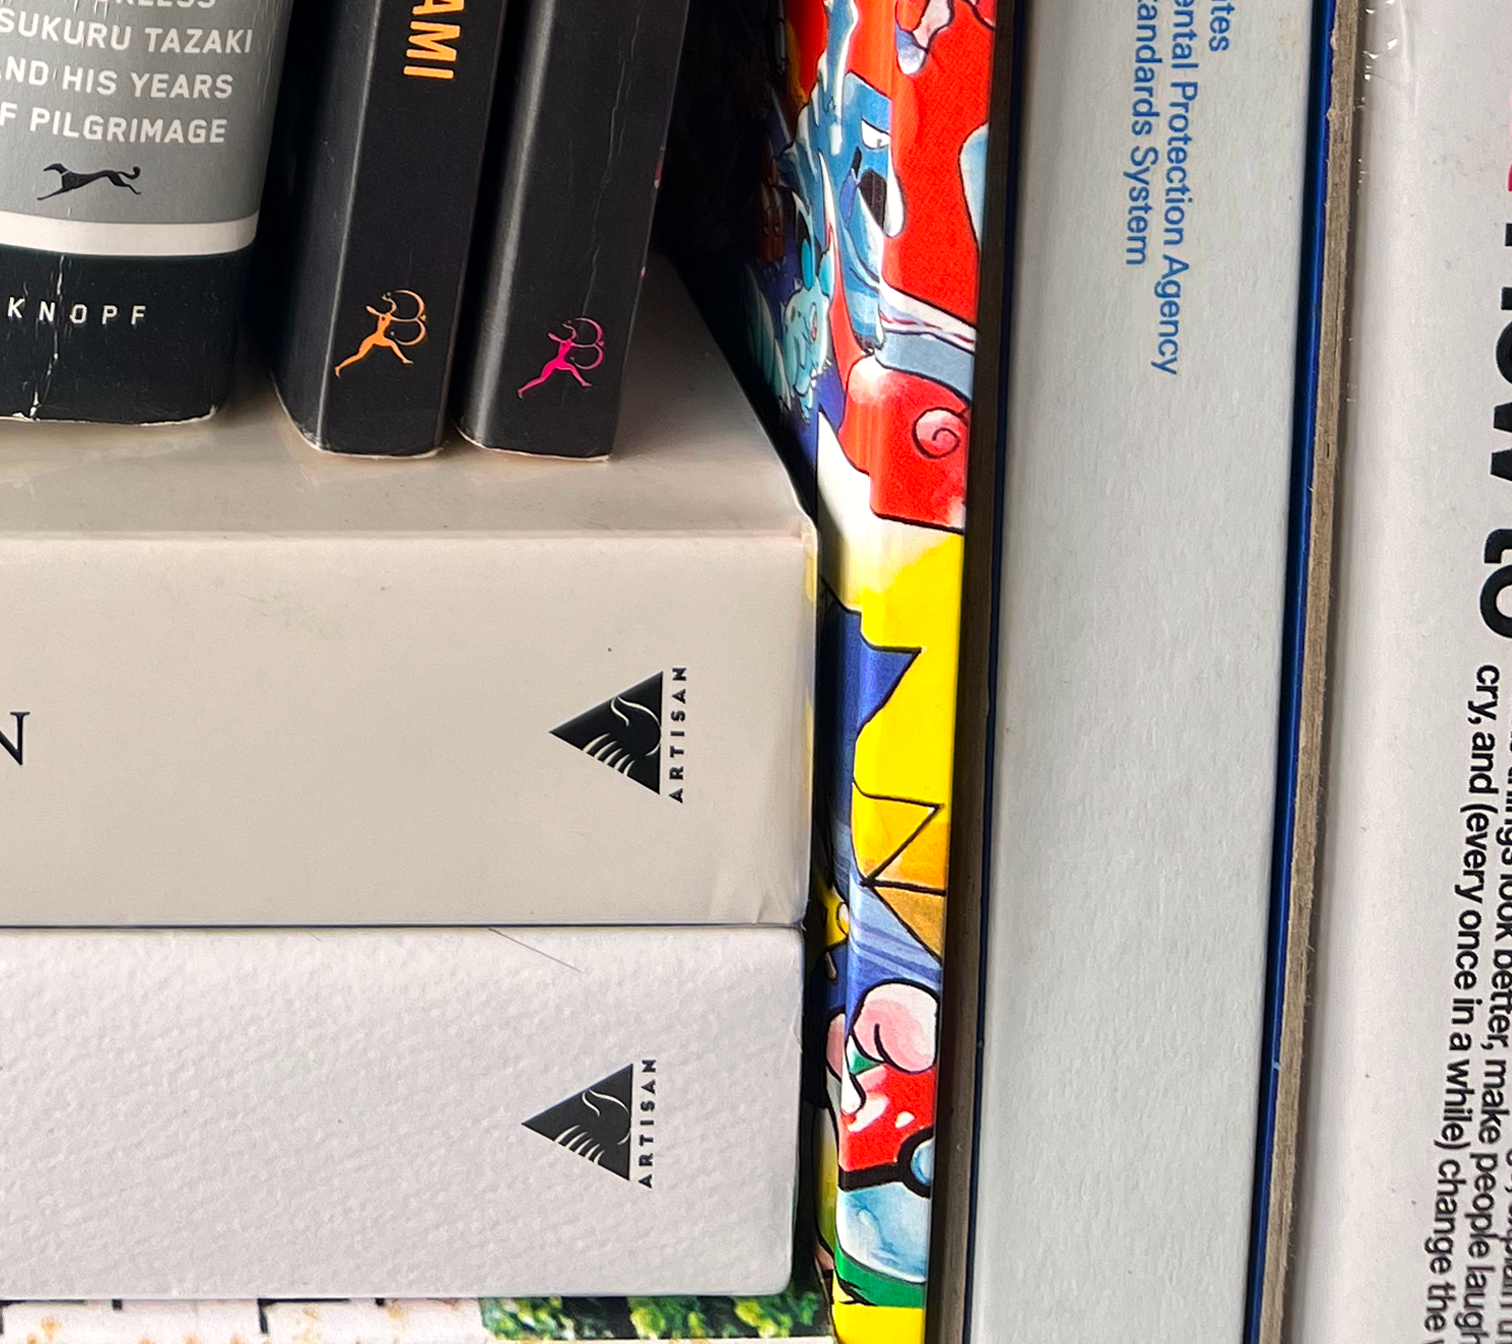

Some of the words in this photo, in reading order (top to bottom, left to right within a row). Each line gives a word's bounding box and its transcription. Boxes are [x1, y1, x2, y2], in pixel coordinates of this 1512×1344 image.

[144, 26, 254, 55] TAZAKI
[62, 66, 118, 98] HIS
[131, 72, 235, 100] YEARS
[29, 107, 228, 145] PILGRIMAGE
[1163, 81, 1199, 247] Protection
[1123, 145, 1159, 266] System
[7, 296, 146, 325] KNOPF
[1150, 254, 1190, 376] Agency
[668, 667, 687, 804] ARTISAN
[1467, 664, 1501, 725] cry,
[1468, 731, 1499, 795] and
[1453, 803, 1498, 904] (every
[1454, 909, 1482, 991] once
[1449, 1031, 1473, 1052] a
[1451, 997, 1482, 1025] in
[637, 1059, 657, 1189] ARTISAN
[1433, 1058, 1475, 1151] while)
[1478, 1059, 1511, 1145] make
[1424, 1158, 1465, 1275] change
[1464, 1152, 1499, 1259] people
[1423, 1281, 1456, 1332] the
